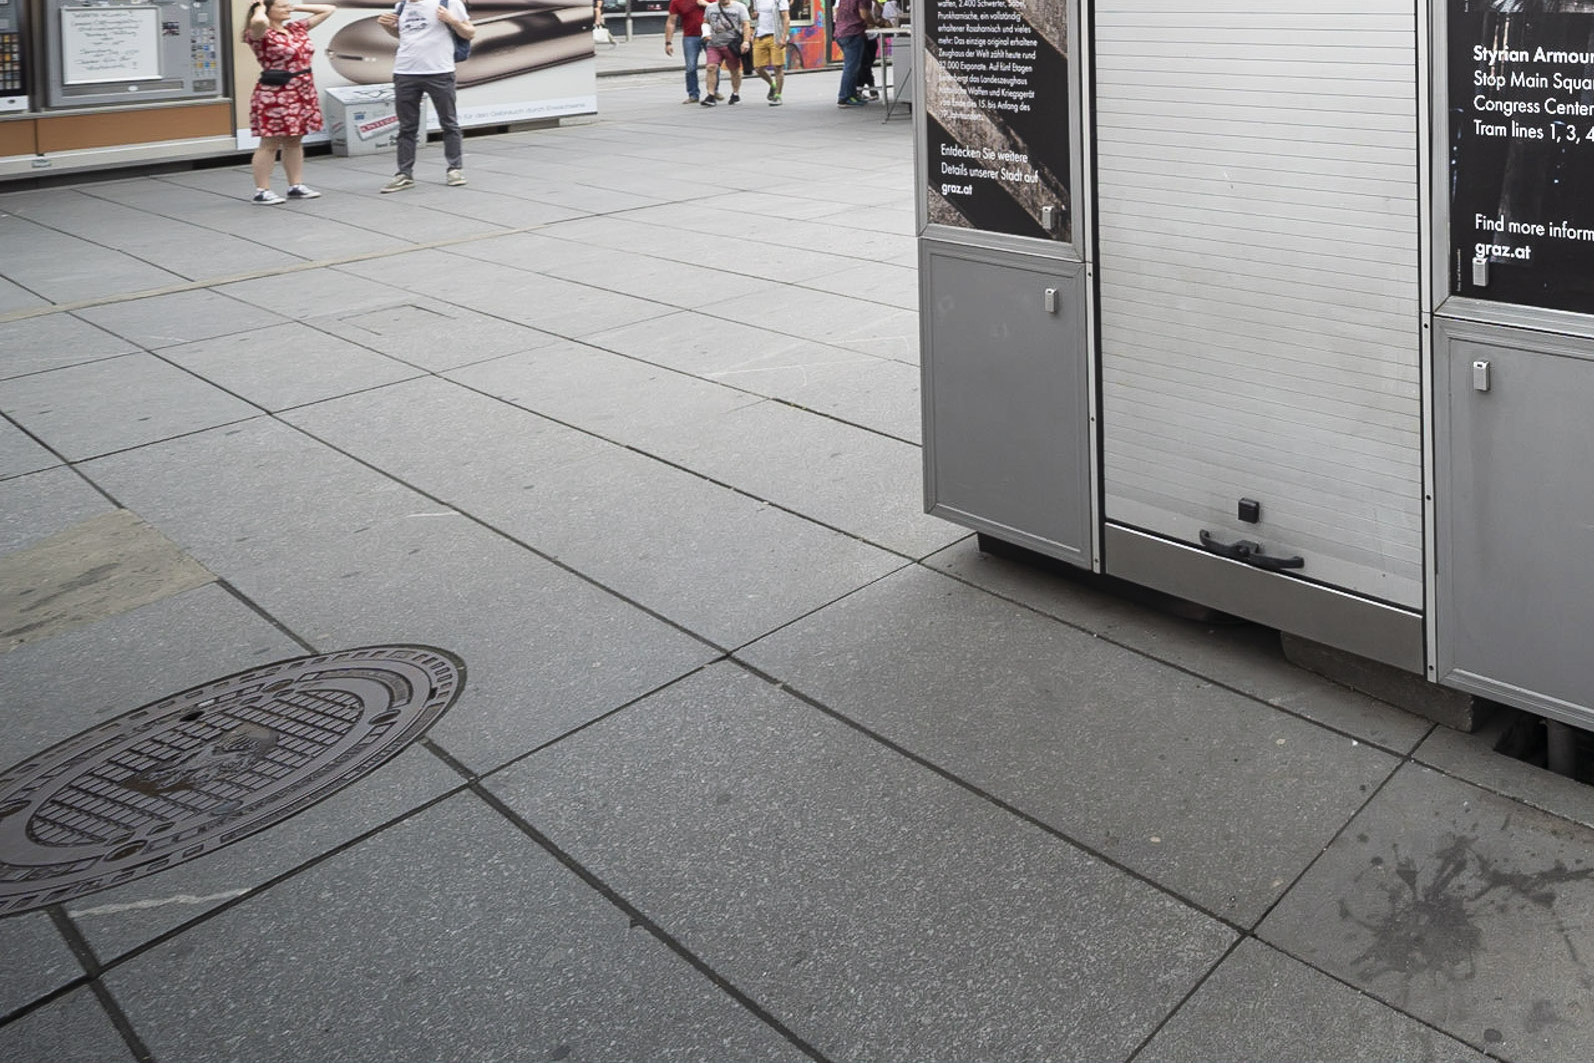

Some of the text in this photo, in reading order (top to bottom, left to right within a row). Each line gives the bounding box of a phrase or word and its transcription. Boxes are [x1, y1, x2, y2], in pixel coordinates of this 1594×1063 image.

[937, 23, 965, 33] erhaltener
[1002, 24, 1014, 33] und
[1014, 24, 1031, 34] vieles
[954, 36, 965, 45] Das
[966, 37, 986, 47] einzige
[987, 37, 1009, 48] original
[1010, 37, 1038, 47] erhaltene
[965, 49, 975, 58] der
[976, 49, 990, 58] Welt
[990, 49, 1005, 59] zählt
[1005, 50, 1021, 59] heute
[1022, 51, 1036, 60] rund
[1473, 44, 1529, 66] Styrian
[988, 62, 999, 71] Auf
[1012, 63, 1033, 74] Etagen
[969, 74, 980, 83] das
[980, 75, 1028, 87] Landeszeughaus
[1473, 70, 1506, 91] Stop
[1510, 71, 1548, 88] Main
[968, 86, 988, 96] Waffen
[989, 87, 1000, 96] und
[997, 101, 1018, 113] Anfang
[1019, 102, 1030, 112] des
[1473, 95, 1594, 117] Congress Center
[1473, 119, 1507, 137] Tram
[1511, 120, 1544, 139] lines
[1550, 123, 1561, 143] 1,
[1566, 124, 1581, 144] 3,
[941, 143, 1028, 163] Entdecken Sie weitere
[941, 162, 1039, 183] Details unserer Stadt auf
[941, 183, 973, 195] graz.at
[1475, 213, 1505, 232] Find
[1508, 223, 1545, 236] more
[1475, 242, 1532, 260] graz.at
